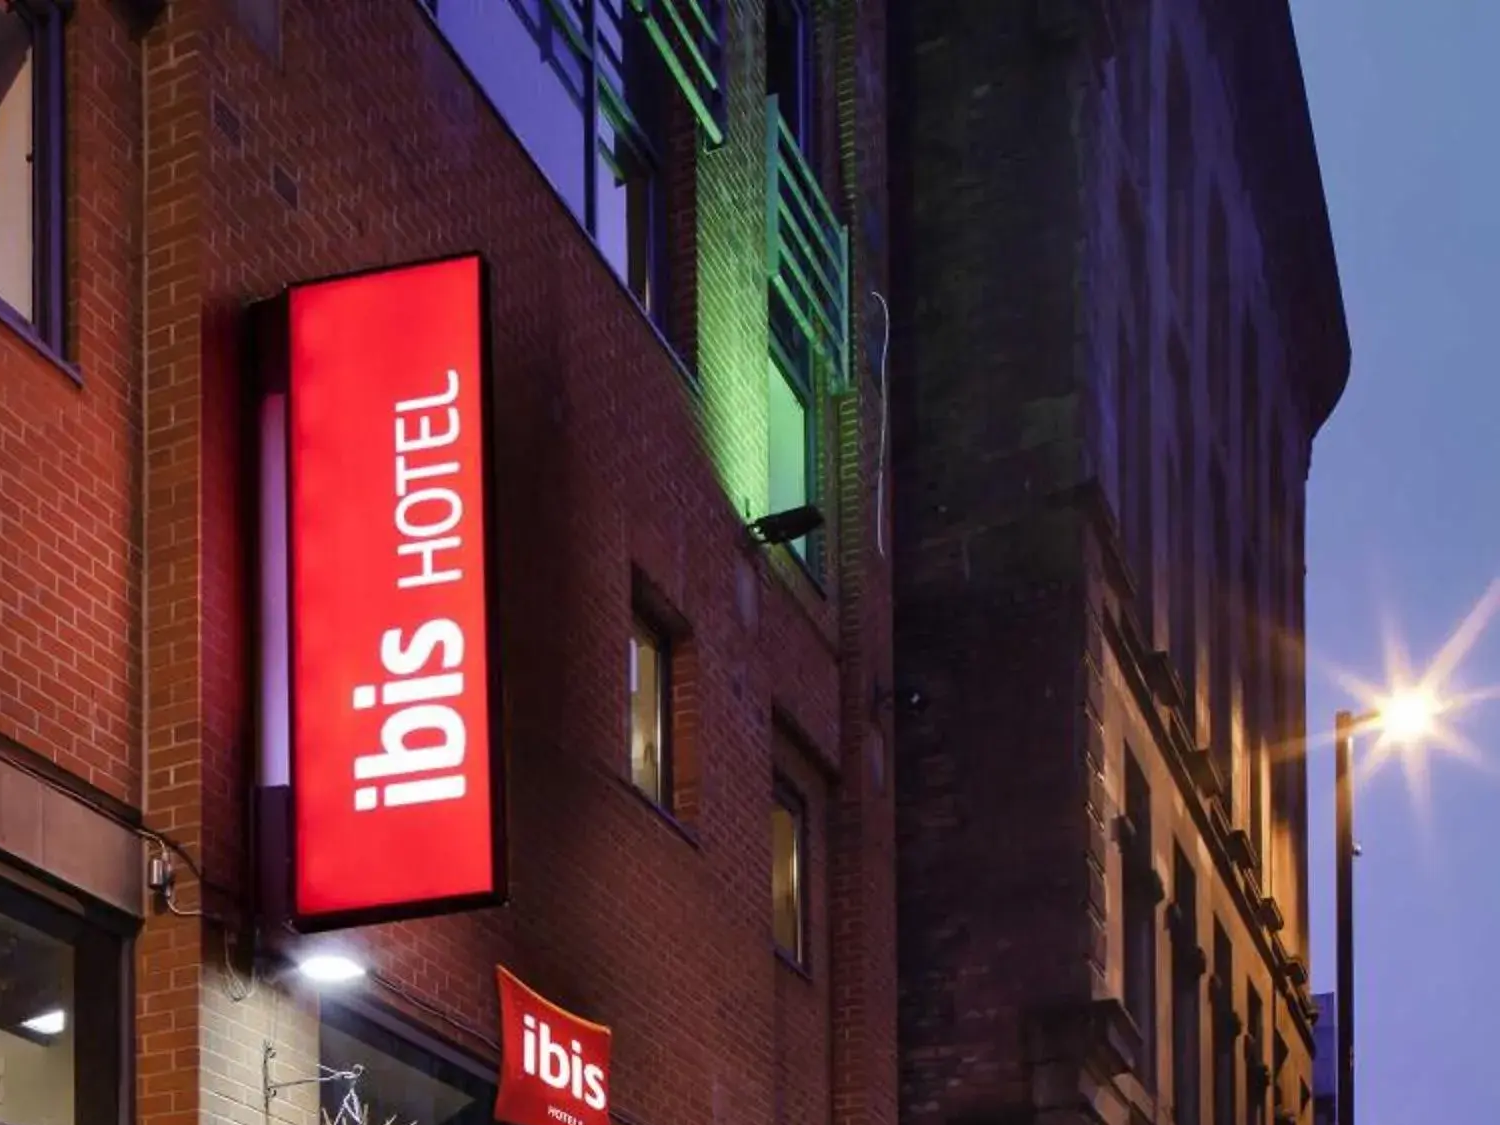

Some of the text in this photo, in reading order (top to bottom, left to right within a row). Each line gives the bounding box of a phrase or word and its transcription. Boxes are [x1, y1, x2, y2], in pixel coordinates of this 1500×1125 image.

[353, 370, 466, 811] ibis HOTEL
[524, 1014, 605, 1110] ibis
